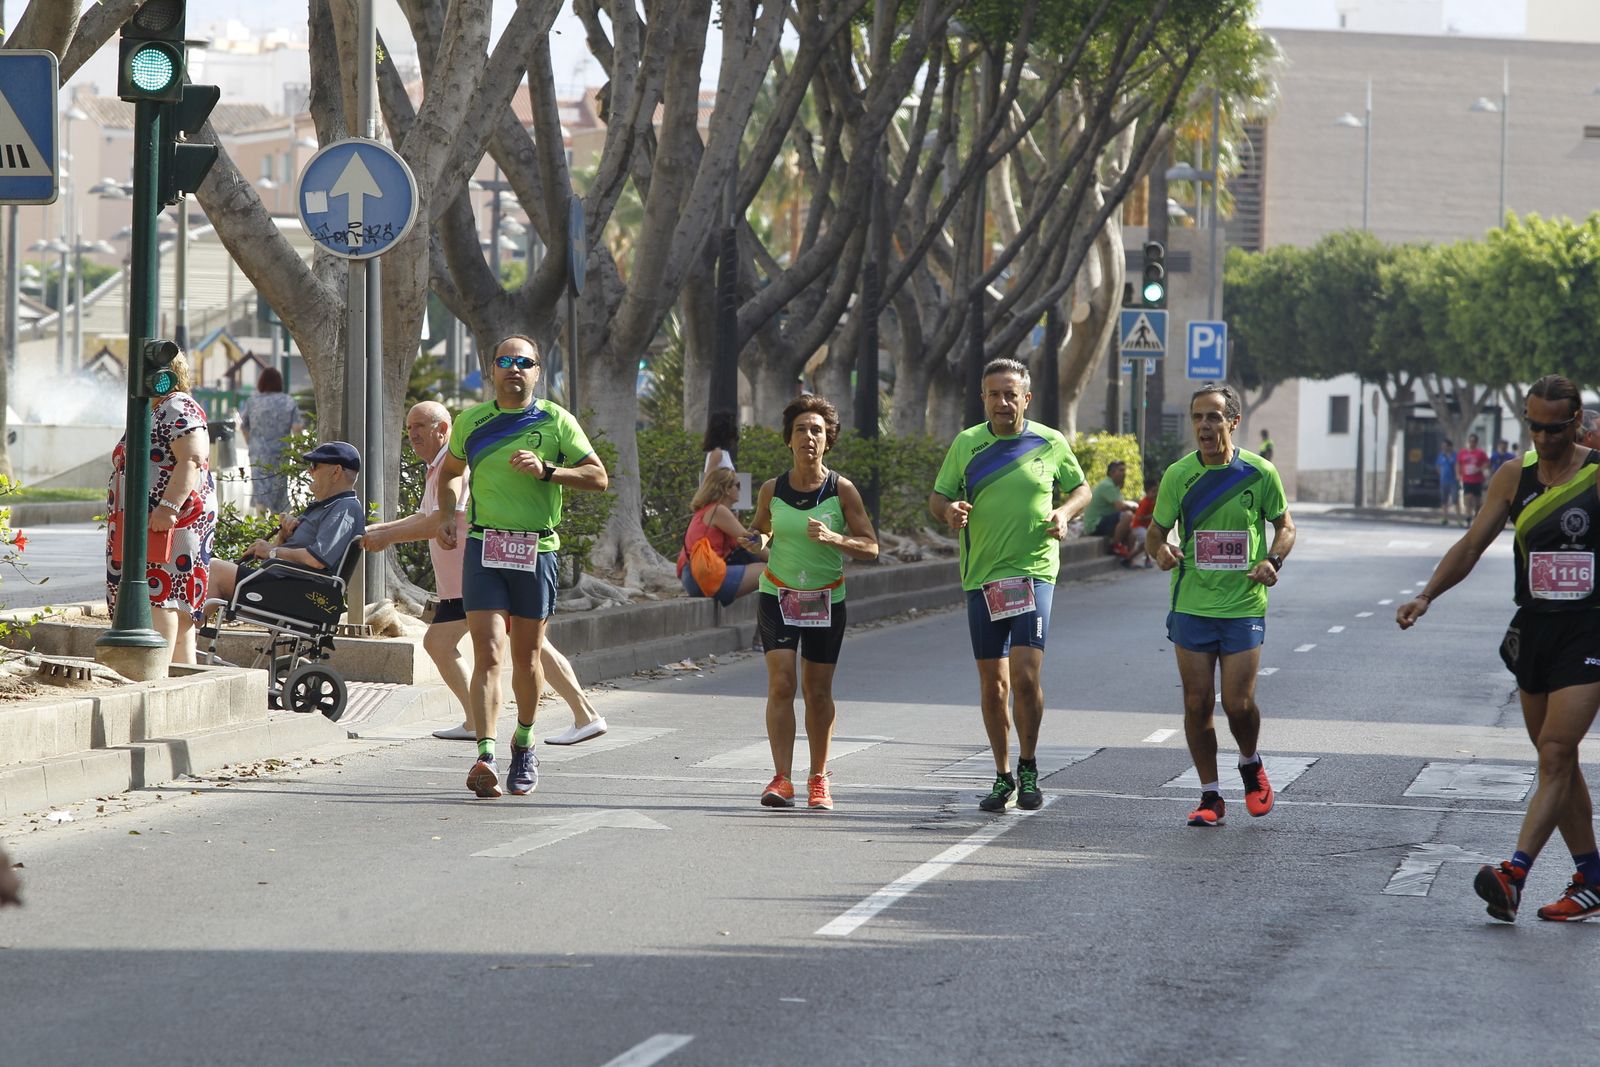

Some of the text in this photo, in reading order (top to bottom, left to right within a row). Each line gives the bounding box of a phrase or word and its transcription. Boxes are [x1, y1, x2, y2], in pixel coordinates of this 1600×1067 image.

[1192, 325, 1215, 359] P
[500, 541, 535, 556] 1087
[1217, 542, 1243, 555] 198
[1549, 566, 1590, 580] 1116
